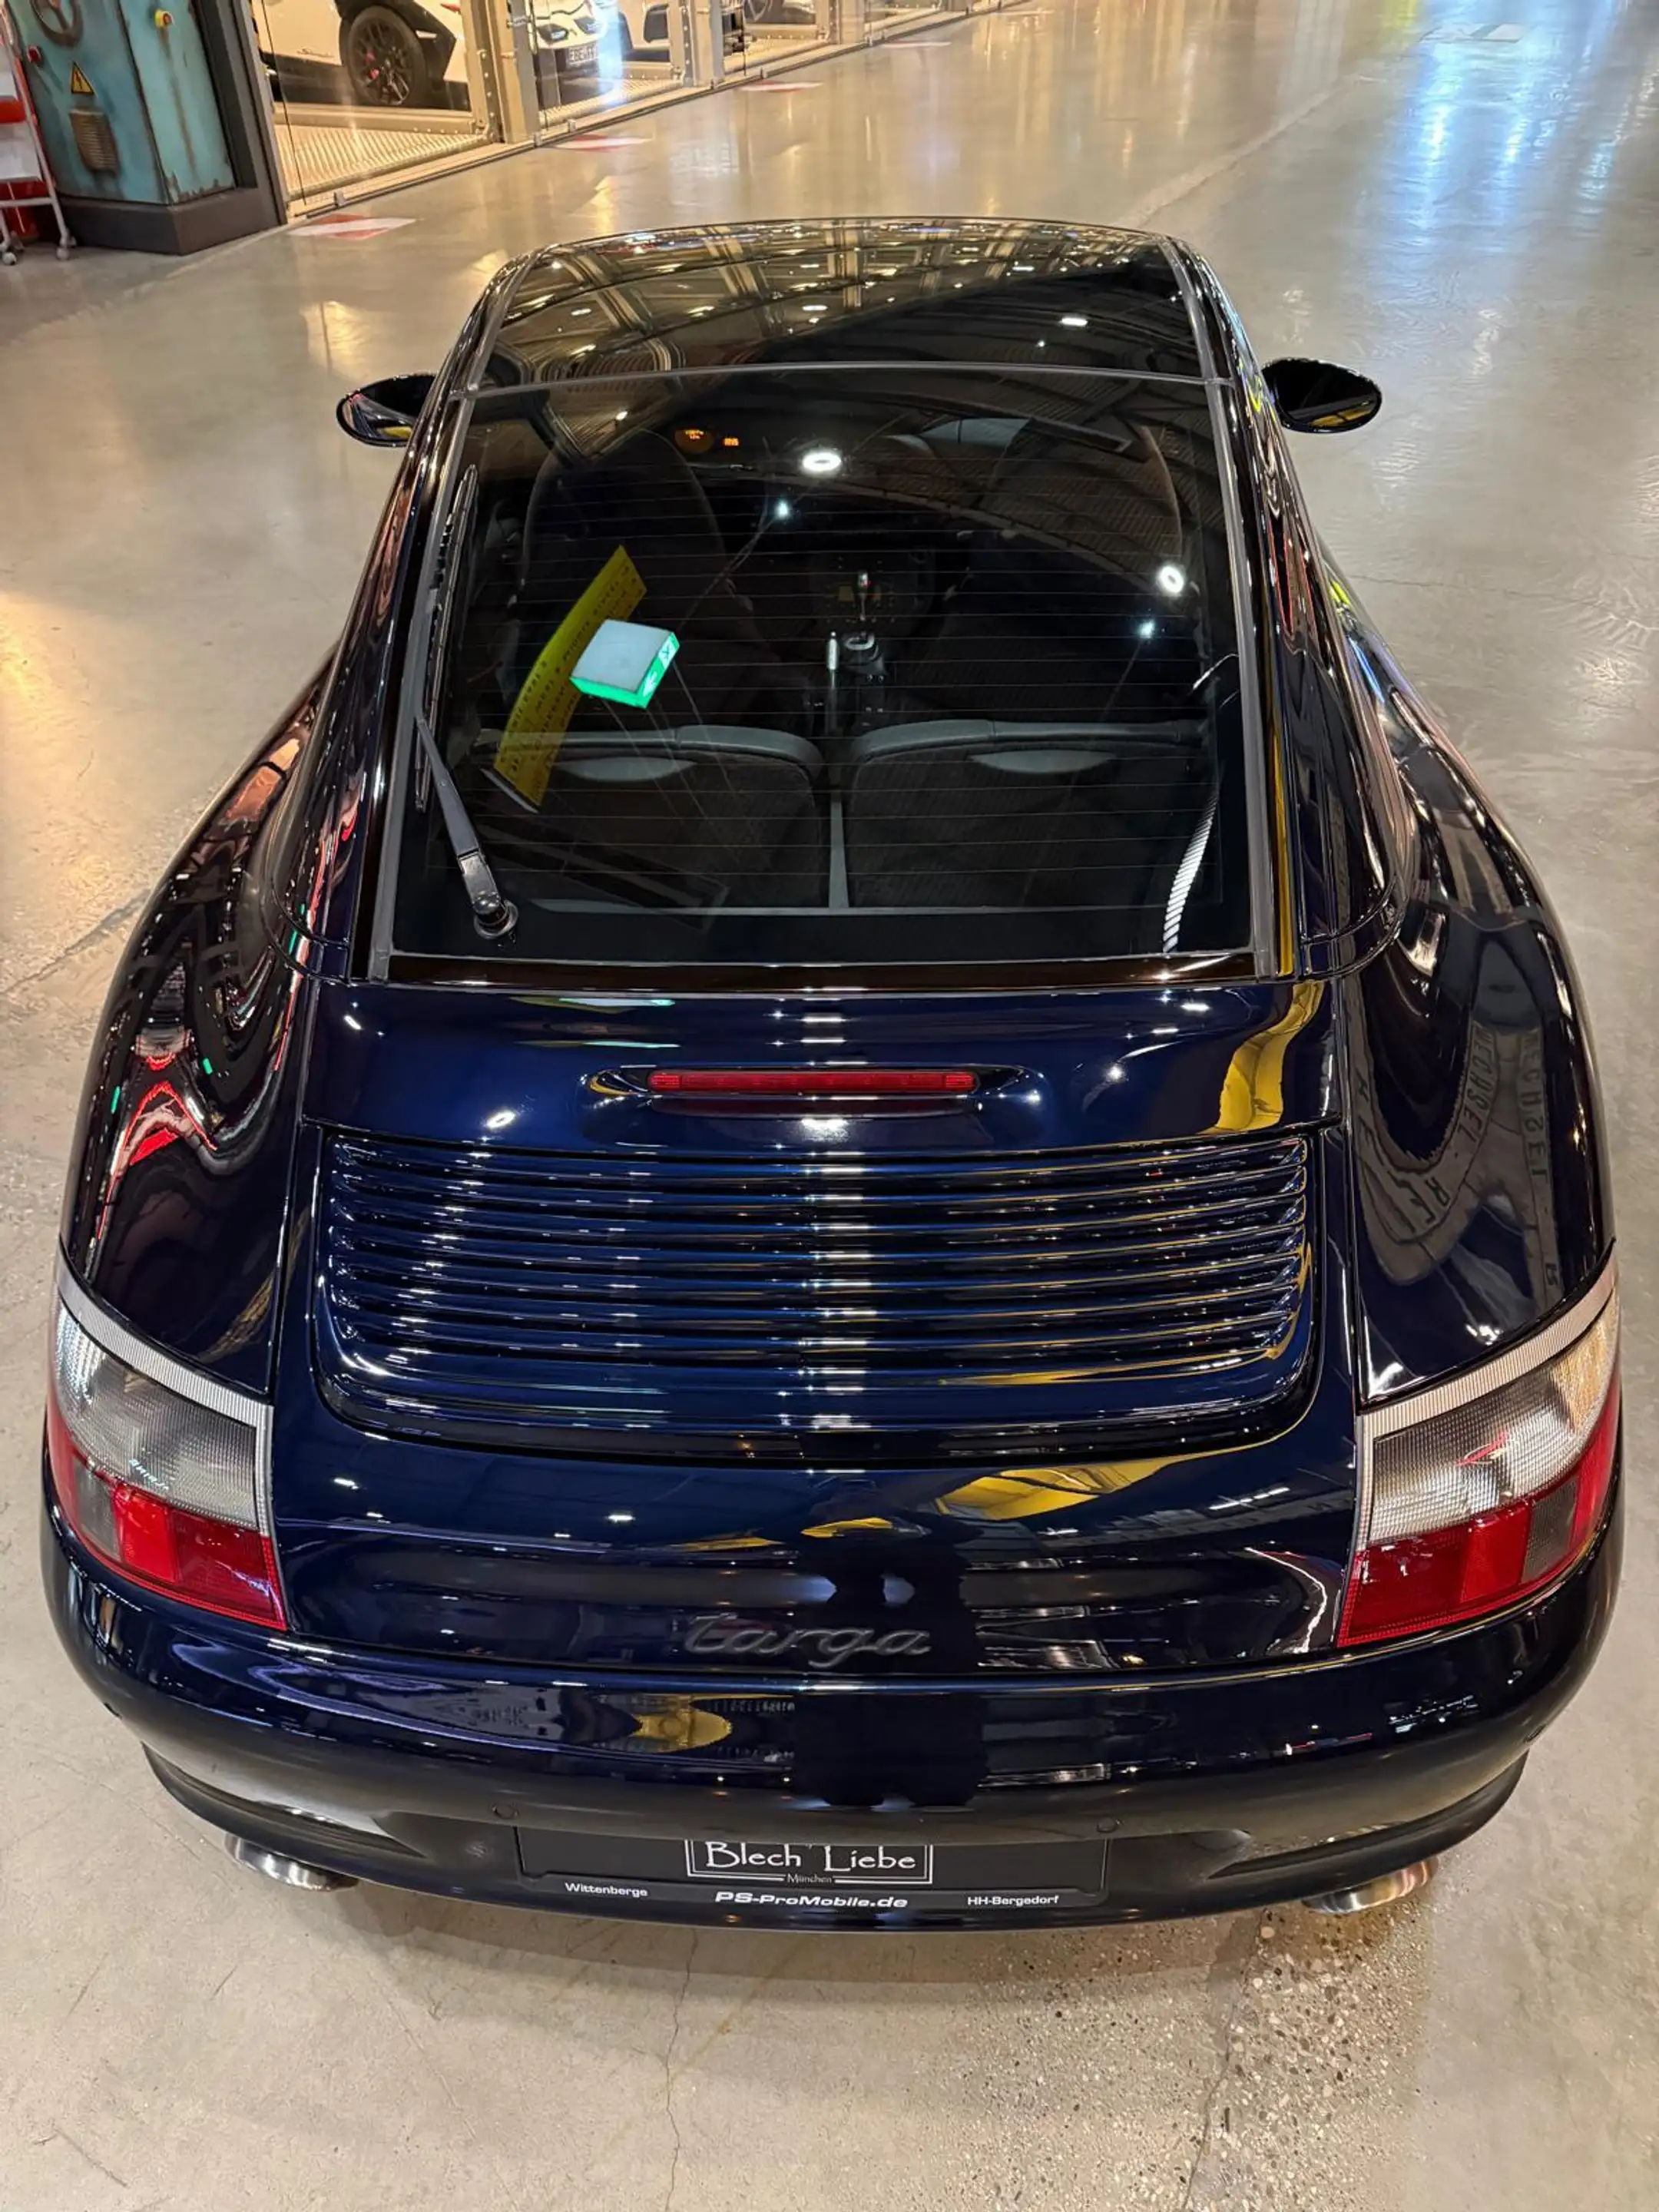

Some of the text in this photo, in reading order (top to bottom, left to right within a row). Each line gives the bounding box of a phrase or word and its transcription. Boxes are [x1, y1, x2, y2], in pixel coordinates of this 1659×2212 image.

[685, 1613, 932, 1667] targa
[705, 1841, 916, 1872] Blech Liebe
[565, 1882, 648, 1898] Wittenberge
[715, 1891, 908, 1908] PS-ProMobile.de
[967, 1895, 1060, 1907] HH-Bergedorf
